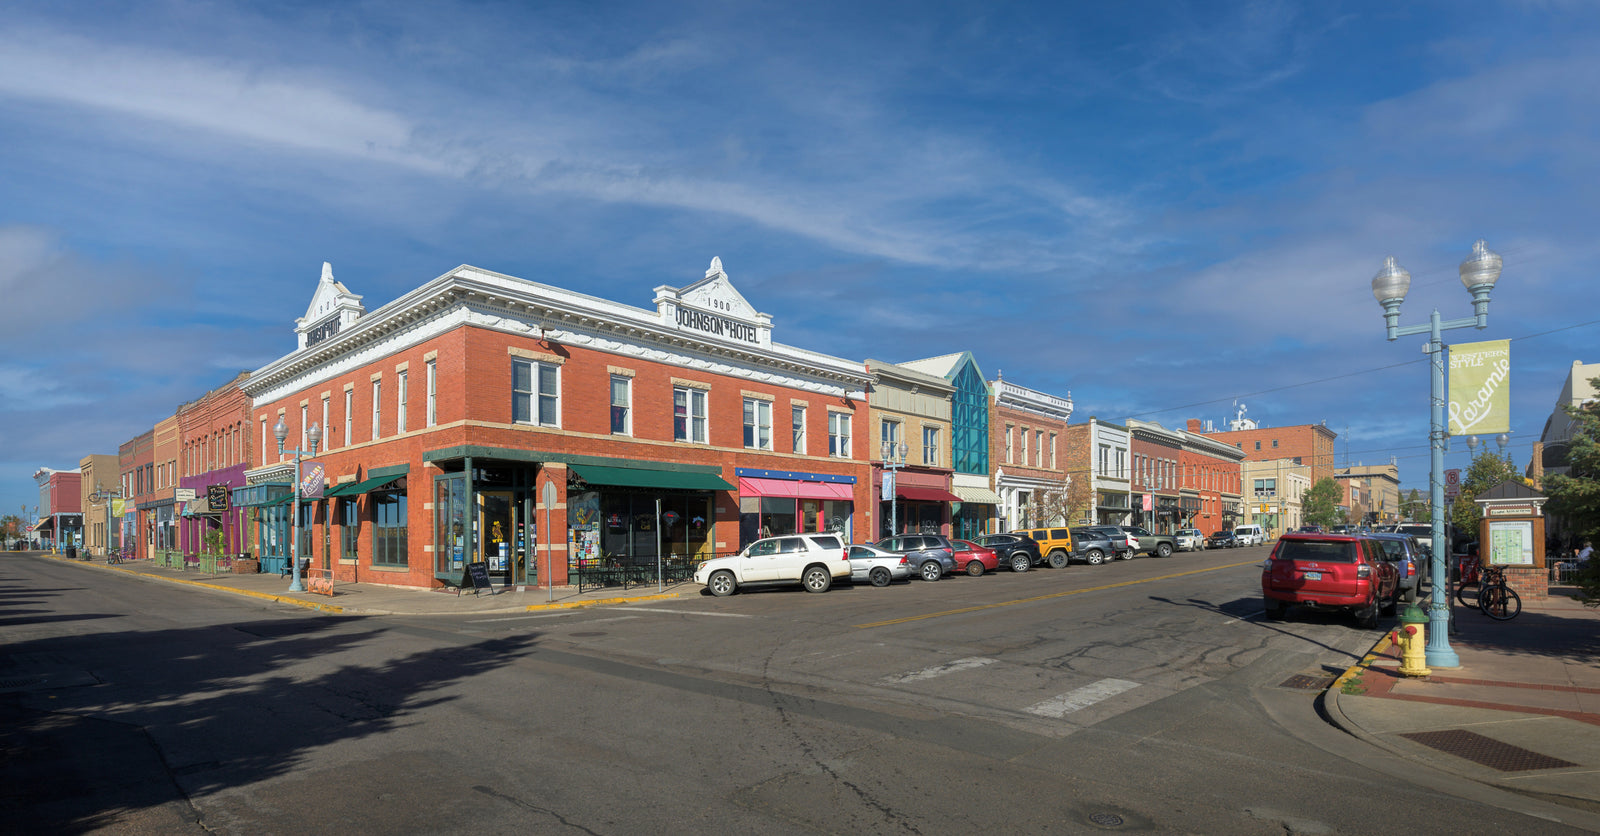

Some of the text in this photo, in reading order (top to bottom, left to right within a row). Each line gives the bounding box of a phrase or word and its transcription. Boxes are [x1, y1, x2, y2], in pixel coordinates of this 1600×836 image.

[708, 298, 730, 311] 1900
[729, 322, 760, 344] HOTEL
[1451, 350, 1507, 360] WESTERN
[1450, 357, 1484, 369] STYLE
[1448, 359, 1510, 435] Laramie
